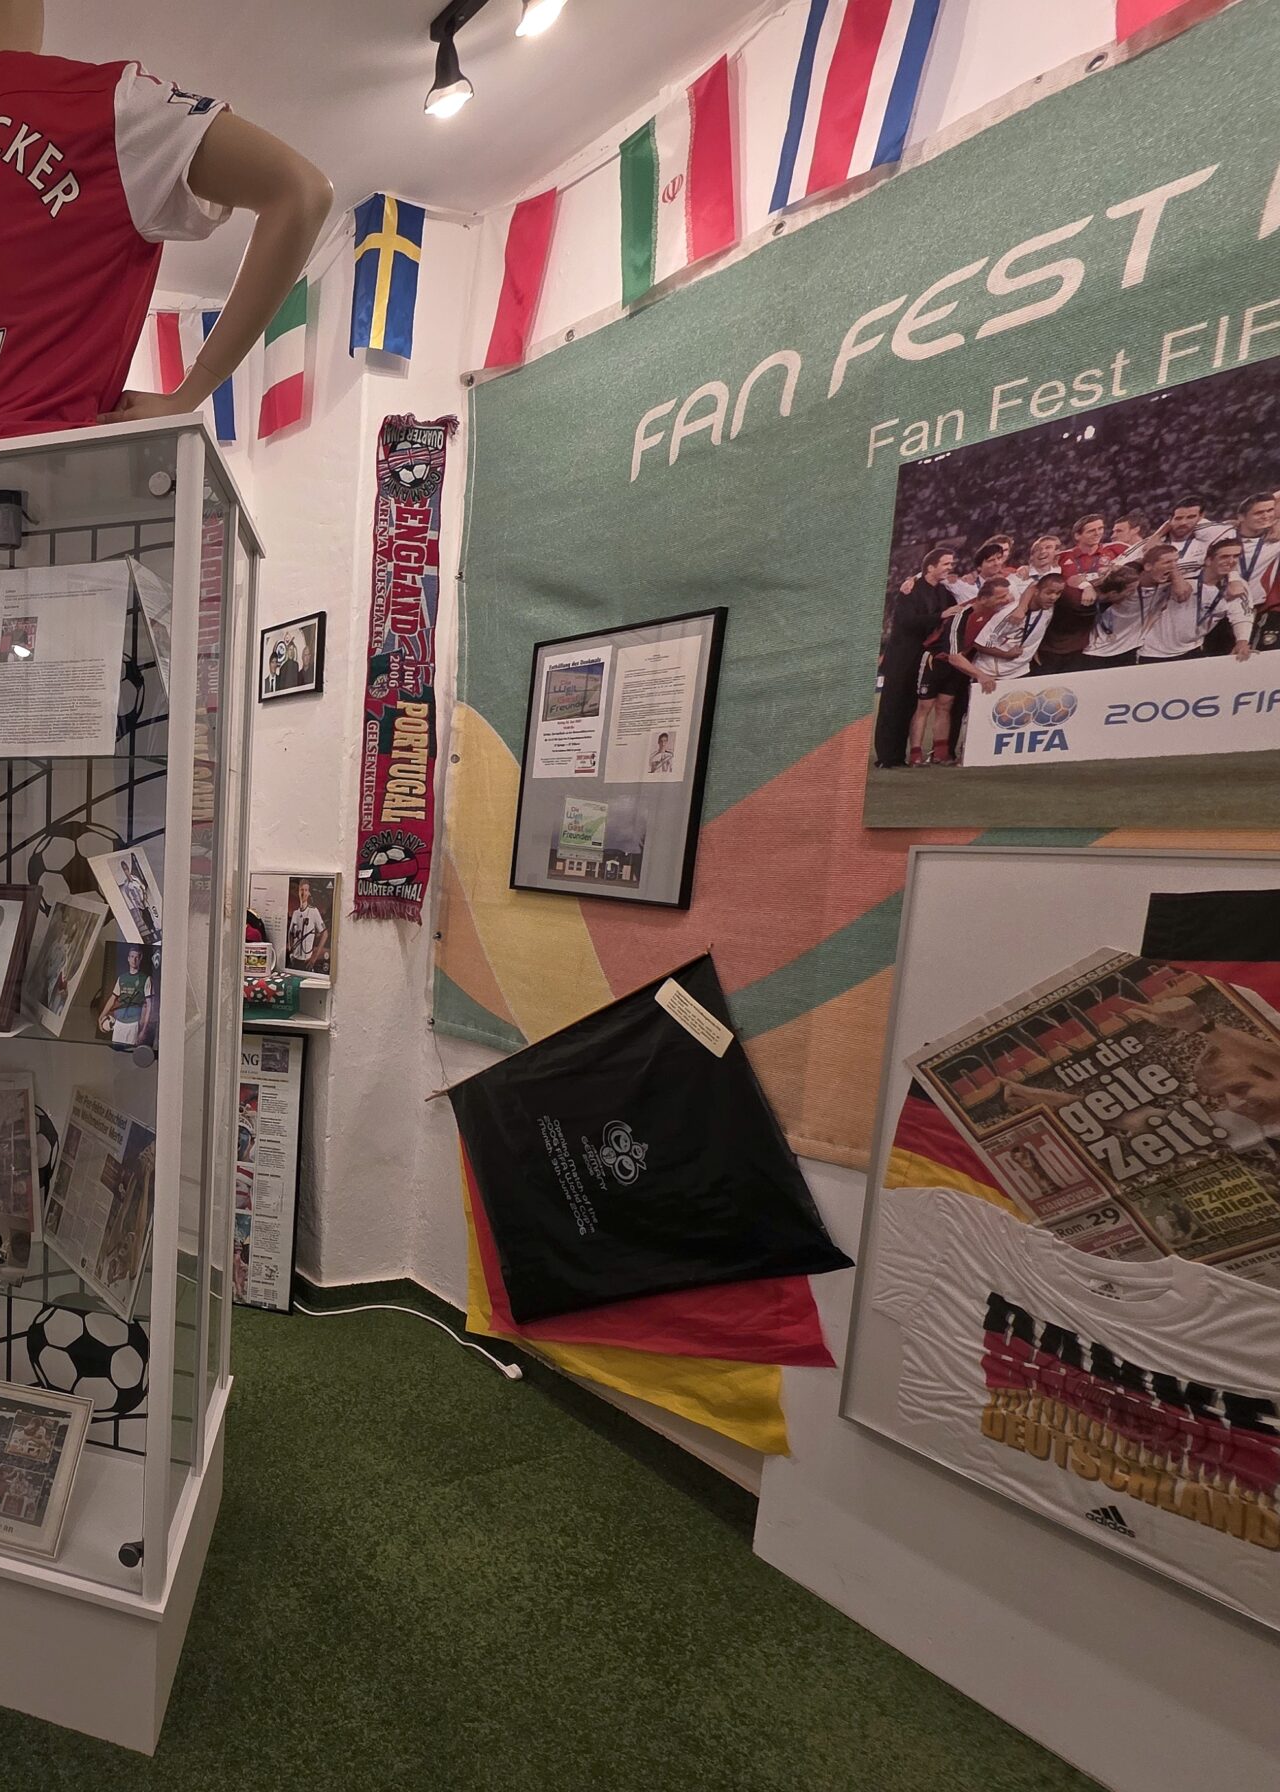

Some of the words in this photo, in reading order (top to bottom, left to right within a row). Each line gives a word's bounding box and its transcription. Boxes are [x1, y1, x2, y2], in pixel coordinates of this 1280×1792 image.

[630, 349, 802, 483] FAN
[827, 164, 1220, 398] FEST
[867, 409, 964, 467] Fan
[988, 348, 1130, 431] Fest
[407, 428, 444, 450] QUARTER
[382, 471, 441, 505] GERMANY
[376, 496, 390, 552] ARENA
[391, 506, 432, 636] ENGLAND
[372, 555, 388, 650] AUFSCHALKE
[389, 656, 400, 689] 2006
[404, 661, 416, 693] July
[1104, 695, 1220, 726] 2006
[994, 729, 1070, 755] FIFA
[362, 720, 380, 831] GELSENKIRCHEN
[381, 701, 429, 823] PORTUGAL
[361, 829, 427, 860] GERMANY
[357, 880, 395, 897] QUARTER
[395, 883, 423, 902] FINAL
[1054, 1057, 1099, 1087] für
[1095, 1036, 1145, 1067] die
[1058, 1063, 1180, 1142] geile
[1086, 1099, 1228, 1181] Zeit!
[543, 1115, 560, 1147] 2006
[555, 1147, 569, 1171] FIFA
[564, 1172, 582, 1204] World
[581, 1135, 608, 1191] GERMANY
[995, 1134, 1088, 1200] Bld
[559, 1177, 572, 1201] June
[569, 1202, 587, 1237] 2006
[1037, 1185, 1097, 1214] HANNOVER
[1184, 1196, 1206, 1210] für
[1203, 1178, 1259, 1204] Zidane!
[1193, 1191, 1270, 1221] Italien
[587, 1207, 599, 1223] the
[1055, 1222, 1086, 1239] Rom
[1086, 1207, 1121, 1228] 29
[1202, 1203, 1280, 1234] Weltmeister
[1086, 1509, 1137, 1538] adidas
